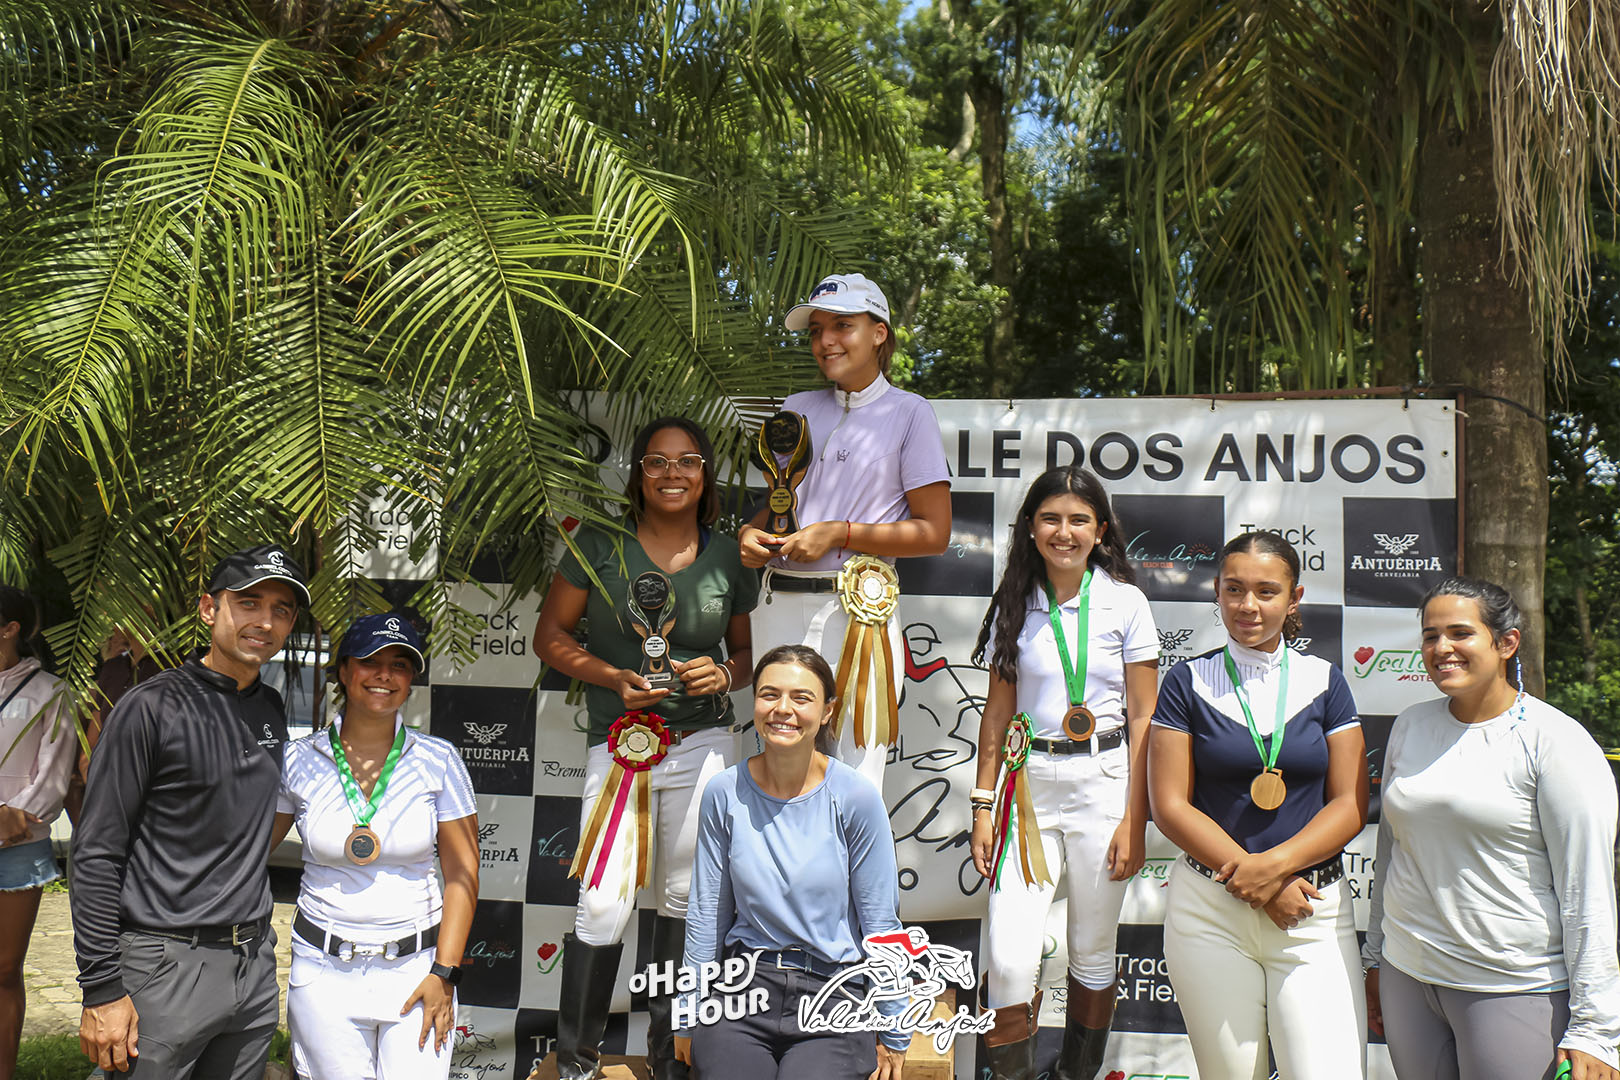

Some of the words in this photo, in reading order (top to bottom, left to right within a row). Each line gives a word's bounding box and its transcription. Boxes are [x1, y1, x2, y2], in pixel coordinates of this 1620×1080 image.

[946, 430, 1021, 478] LE
[1046, 431, 1184, 481] DOS
[1203, 433, 1426, 484] ANJOS
[375, 530, 413, 550] Fiel
[1240, 524, 1316, 545] Tack
[1350, 555, 1443, 571] ANTUÉRPIA
[470, 634, 526, 656] Field
[1397, 674, 1433, 682] MOTE
[458, 744, 530, 762] NTUÉRPIA
[465, 761, 507, 769] ERVEJARIA
[541, 760, 587, 778] Premi
[1114, 953, 1170, 976] Trac
[1134, 979, 1178, 1002] Fie
